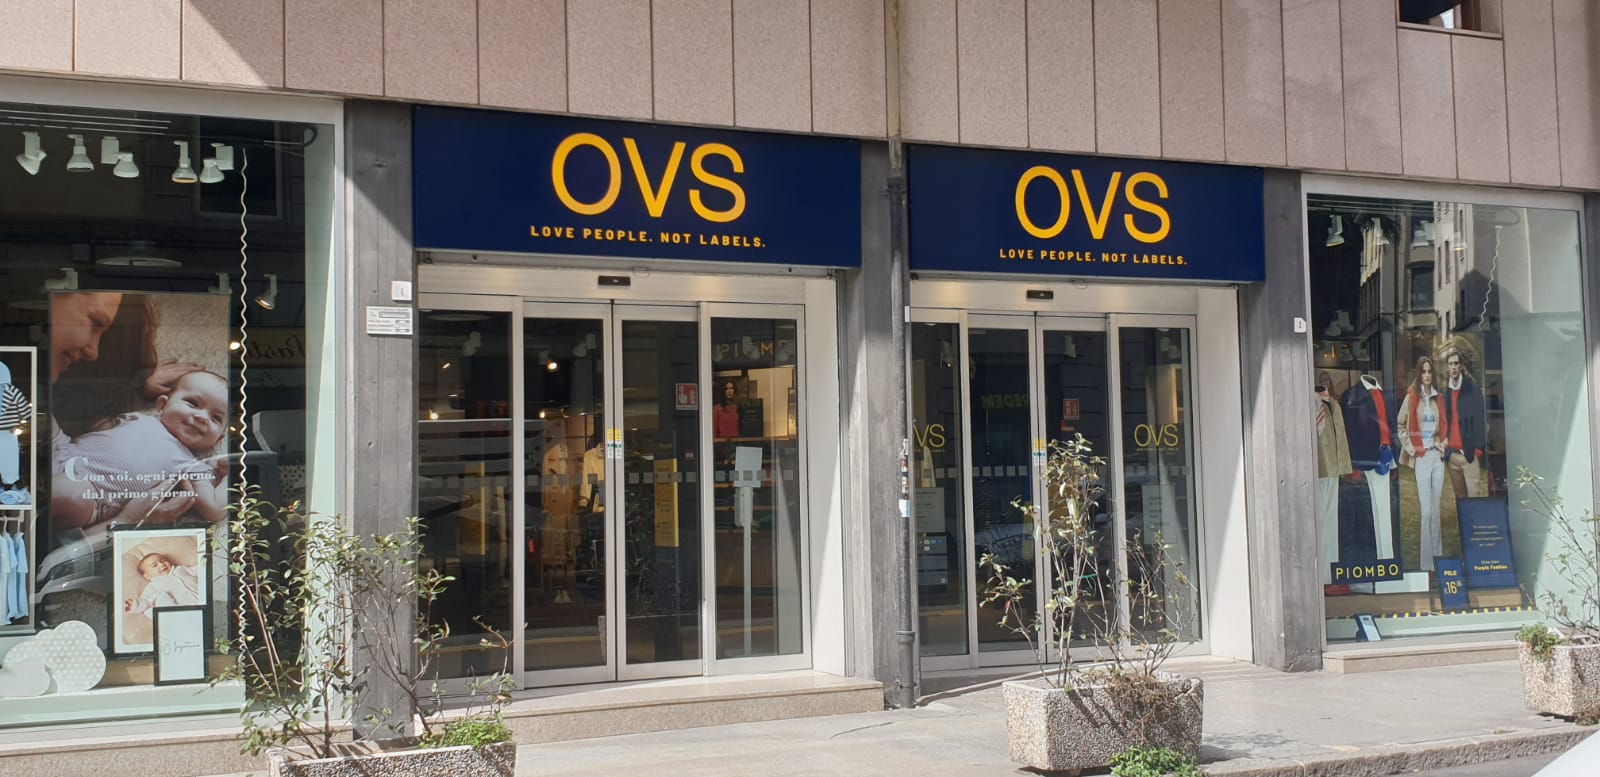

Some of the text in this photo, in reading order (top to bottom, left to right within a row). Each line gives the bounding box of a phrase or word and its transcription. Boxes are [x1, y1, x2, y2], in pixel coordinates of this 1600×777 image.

[551, 132, 747, 223] OVS
[1014, 165, 1172, 244] OVS
[530, 225, 767, 248] LOVE PEOPLE. NOT LABELS.
[999, 248, 1188, 266] LOVE PEOPLE. NOT LABELS.
[1134, 423, 1178, 447] OVS
[64, 456, 105, 483] Con
[136, 470, 166, 484] ogni
[82, 488, 105, 500] dal
[108, 488, 148, 502] primo
[1336, 563, 1399, 580] PIOMBO
